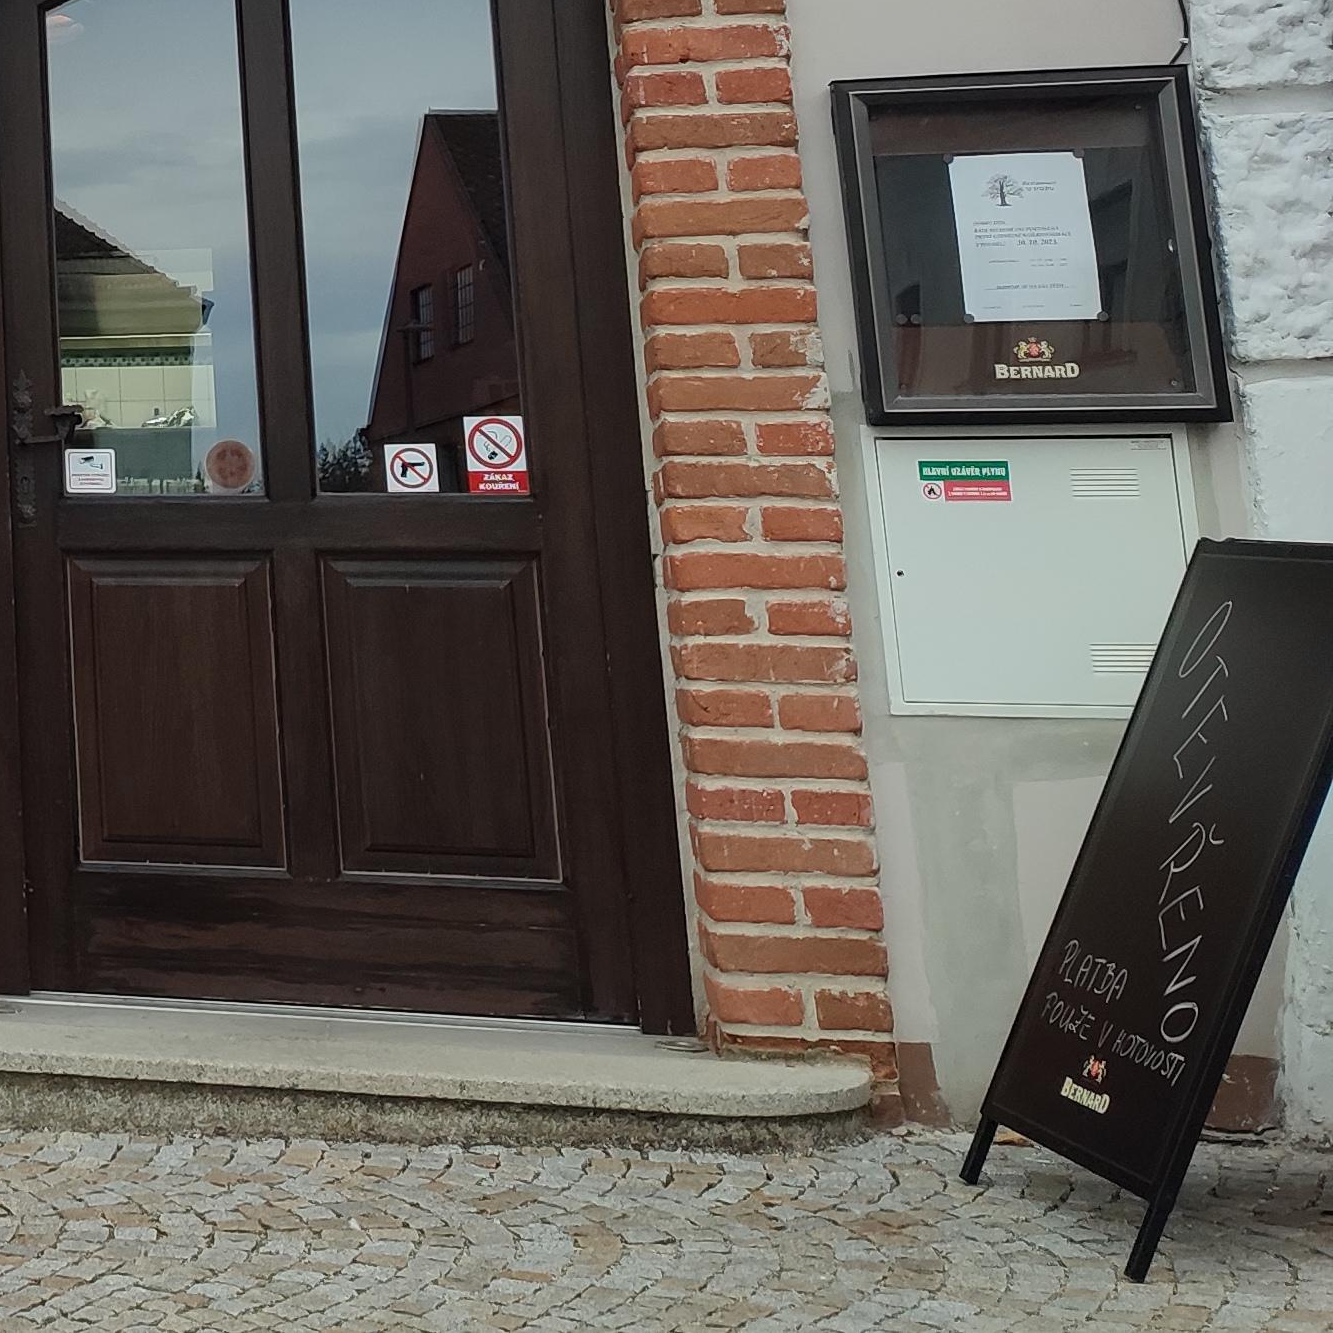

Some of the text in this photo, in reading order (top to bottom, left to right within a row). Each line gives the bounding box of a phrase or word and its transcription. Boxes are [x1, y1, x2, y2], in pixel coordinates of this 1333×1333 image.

[994, 362, 1080, 381] BERNARD
[483, 473, 515, 482] ZÁKAZ
[1158, 600, 1233, 1044] OTEVŘENO
[1058, 939, 1129, 1004] PLATBA
[1097, 1020, 1114, 1049] V
[1111, 1028, 1186, 1087] HOTOVOSTI
[1060, 1076, 1111, 1115] BERNARD
